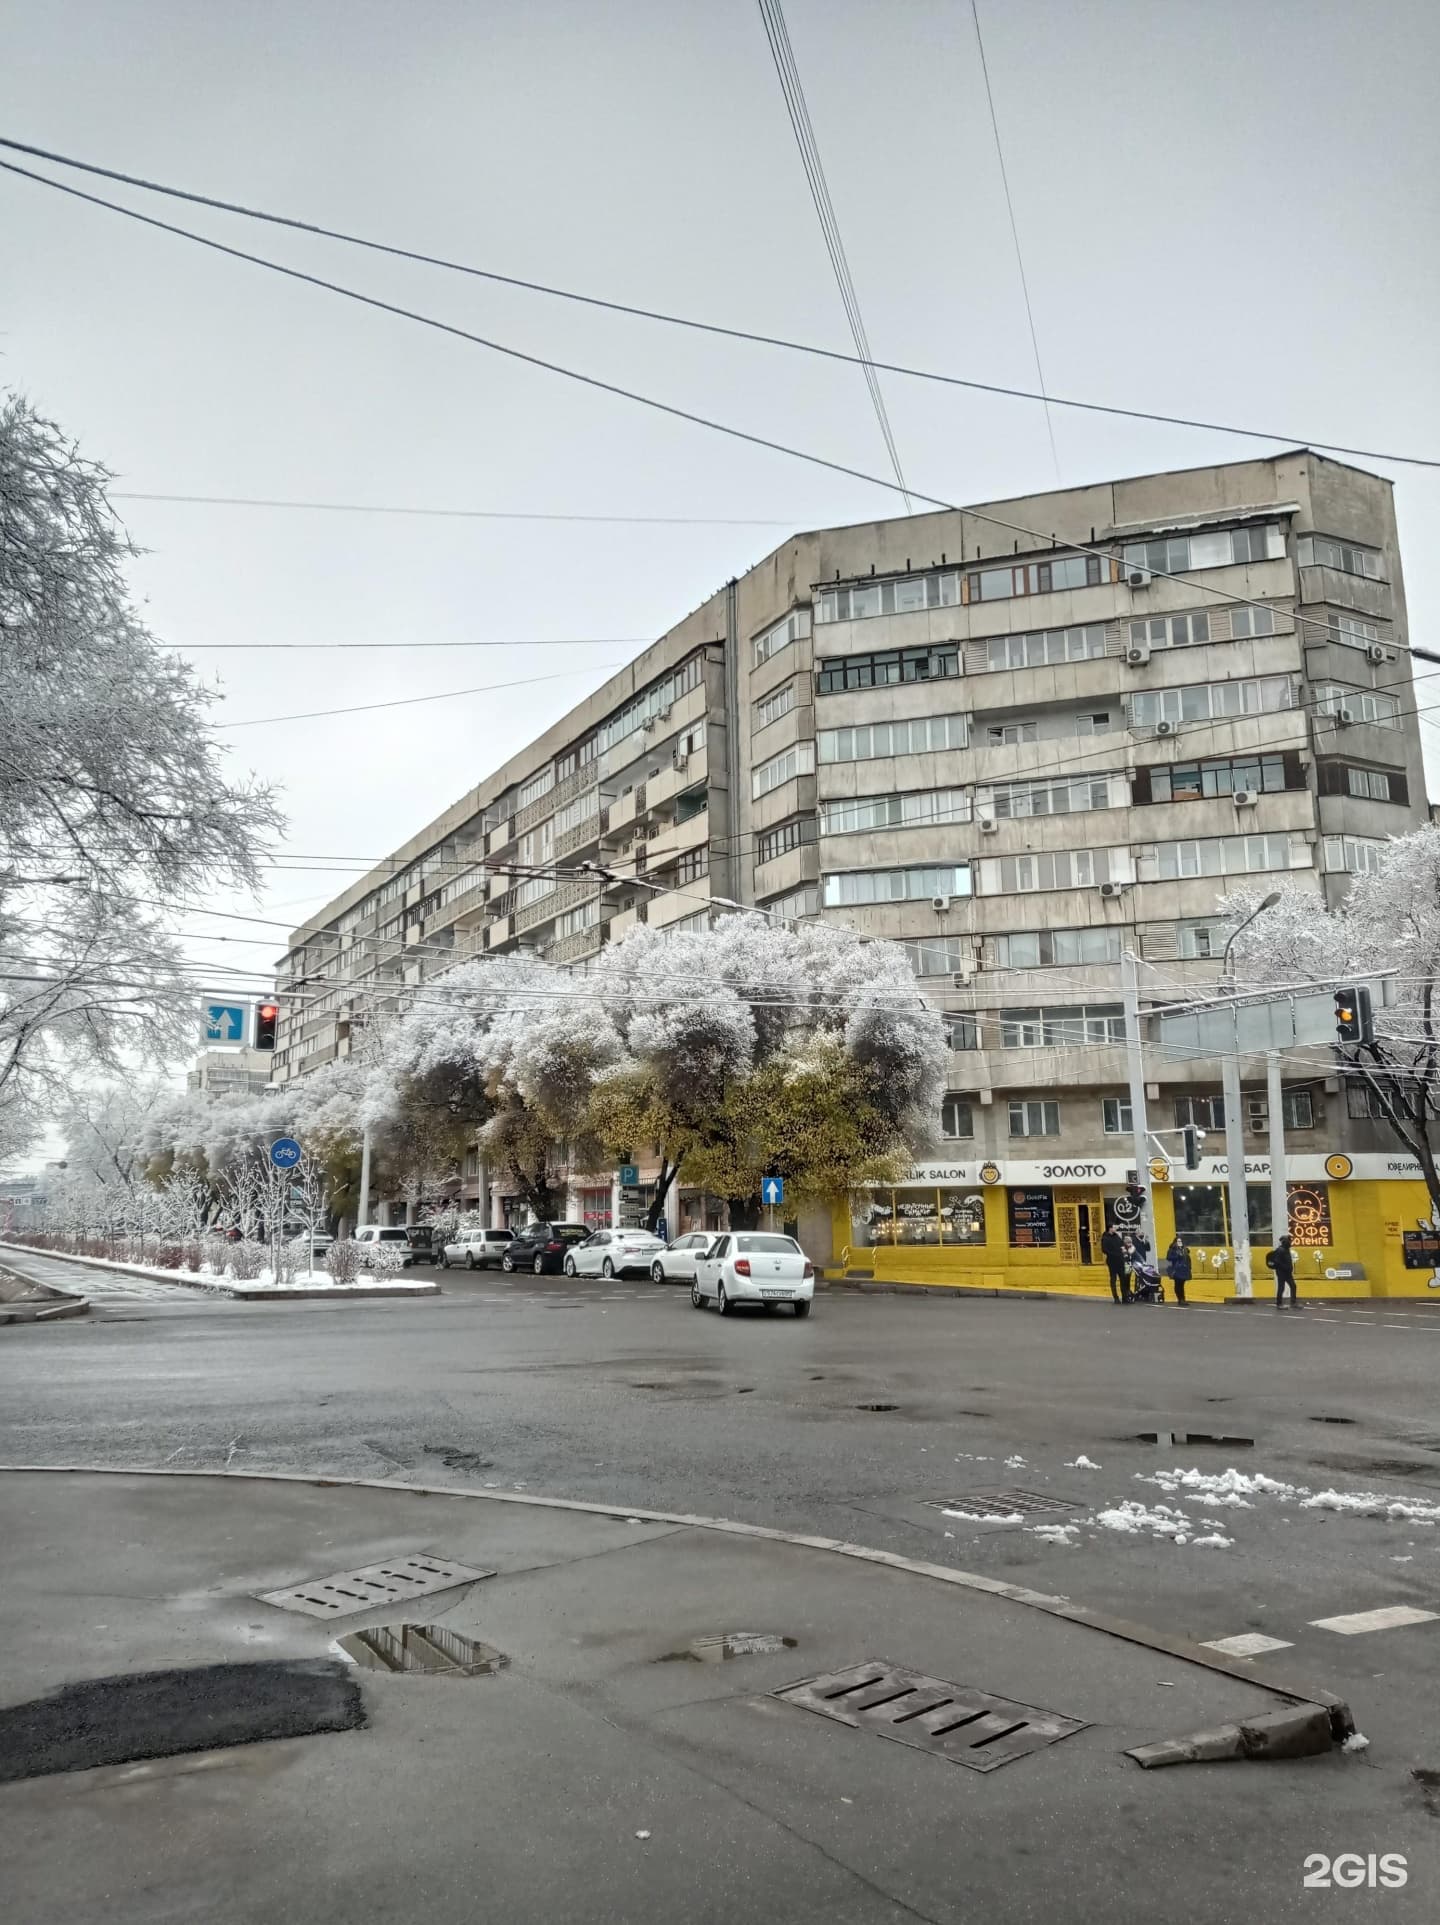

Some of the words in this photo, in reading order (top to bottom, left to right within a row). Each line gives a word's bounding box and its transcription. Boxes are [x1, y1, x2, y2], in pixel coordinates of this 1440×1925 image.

[624, 1168, 634, 1183] P
[929, 1169, 966, 1179] SALON
[1043, 1164, 1106, 1178] ЗОЛОТО
[1211, 1163, 1272, 1175] ЛОБАР
